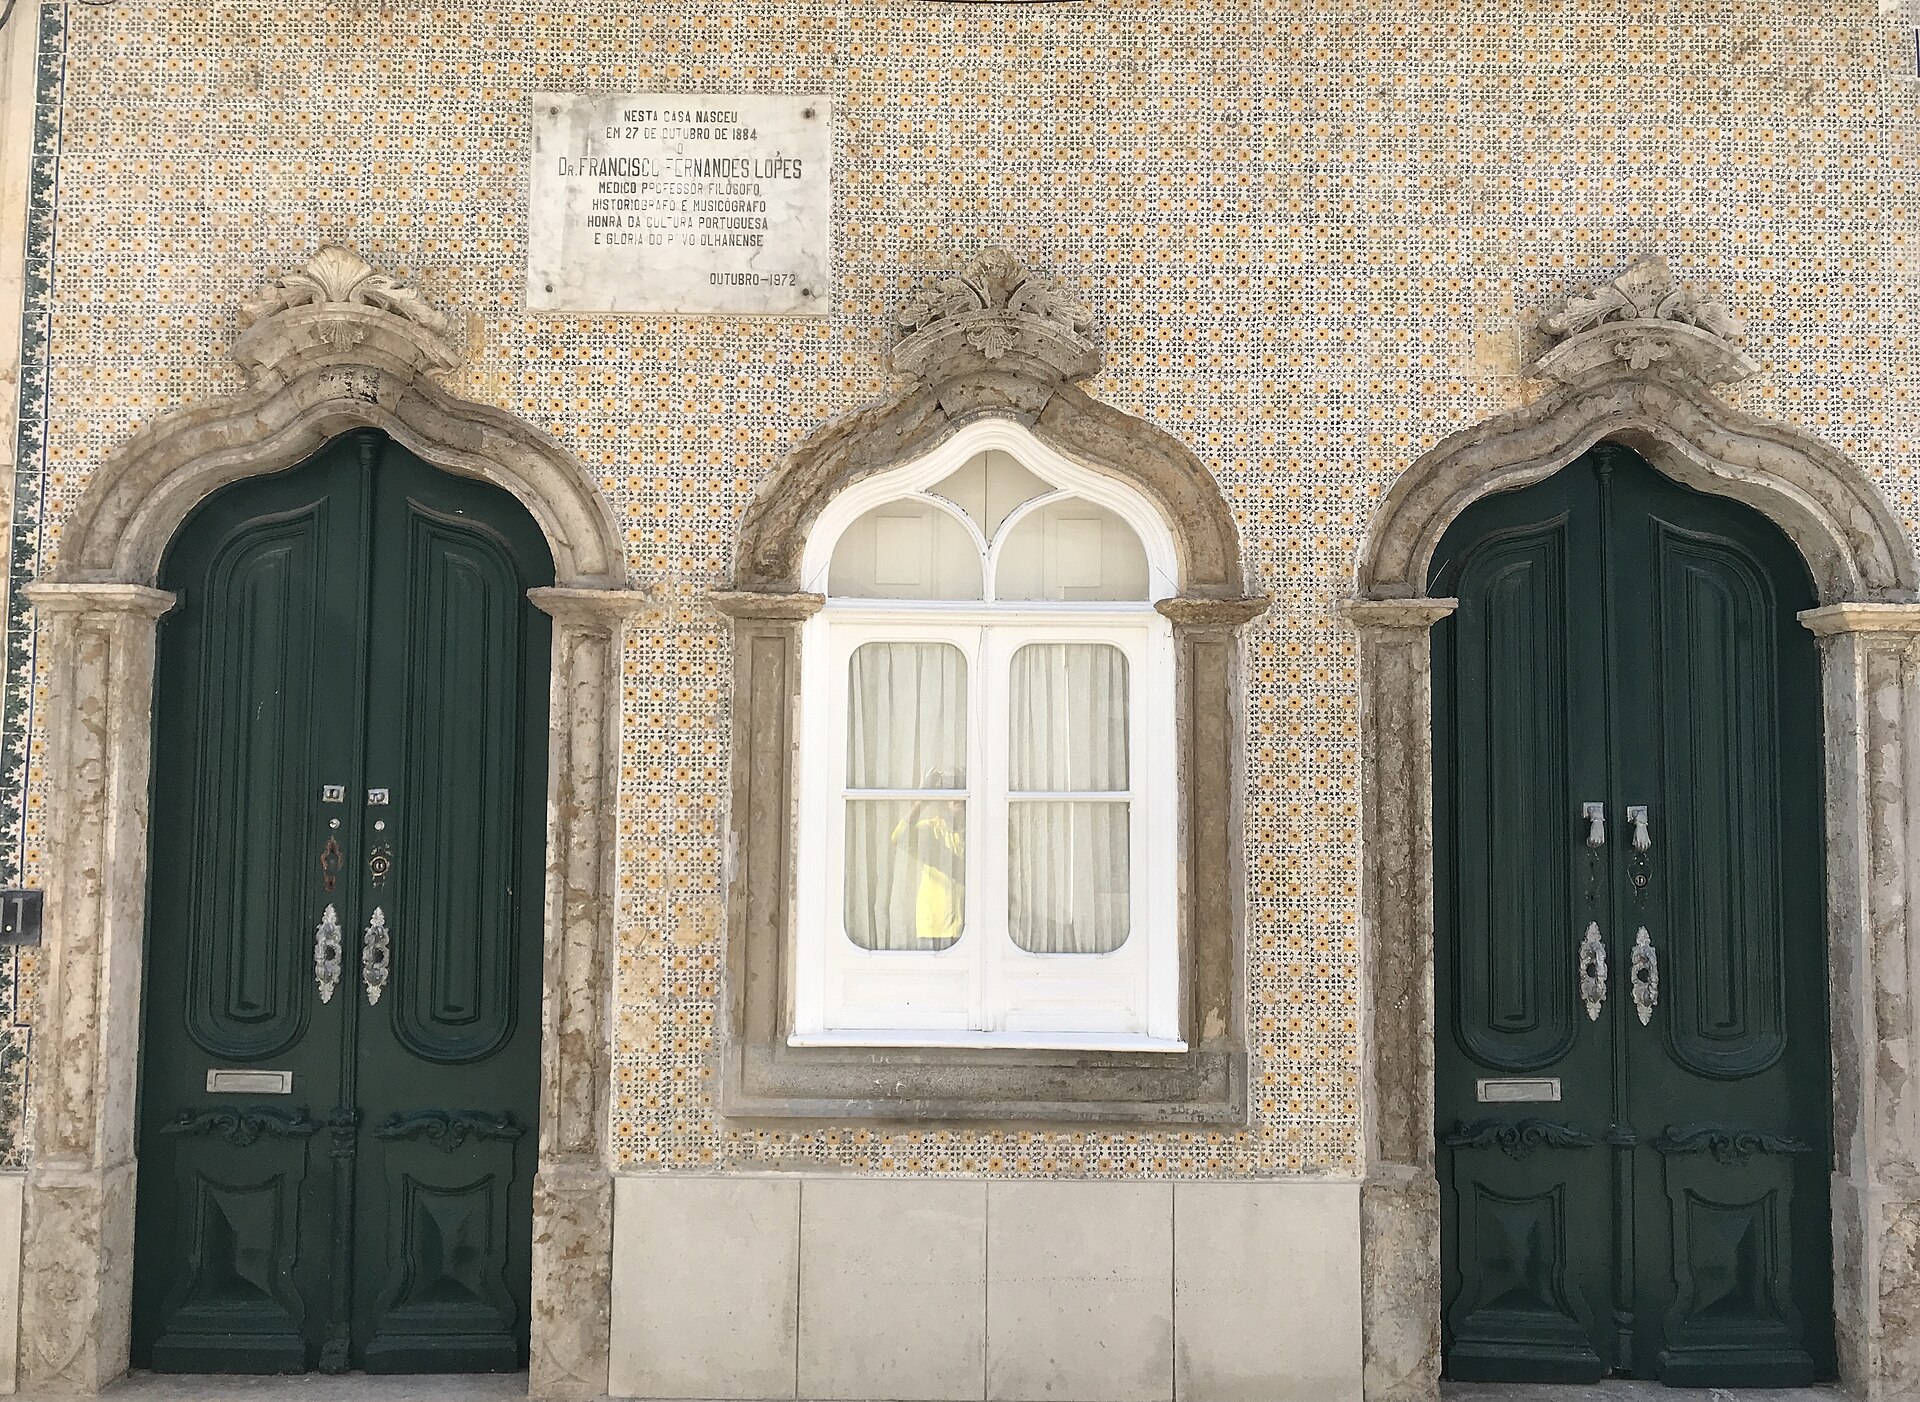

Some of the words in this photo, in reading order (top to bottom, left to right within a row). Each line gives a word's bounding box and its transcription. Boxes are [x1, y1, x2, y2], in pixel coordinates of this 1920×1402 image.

[624, 110, 658, 122] NESTA
[663, 111, 691, 123] CASA
[696, 111, 738, 123] NASCEU
[606, 127, 621, 139] EM
[626, 127, 639, 139] 27
[644, 128, 657, 140] DE
[715, 128, 728, 140] DE
[732, 128, 758, 141] 1884
[592, 199, 676, 212] HISTORIOGRAFO
[682, 200, 688, 212] E
[587, 215, 622, 228] HONRA
[628, 216, 641, 228] DA
[698, 216, 768, 230] PORTUGUESA
[594, 232, 601, 245] E
[606, 233, 643, 245] GLORIA
[649, 233, 663, 246] DO
[668, 233, 696, 246] PVO
[700, 233, 764, 247] OLHANENSE
